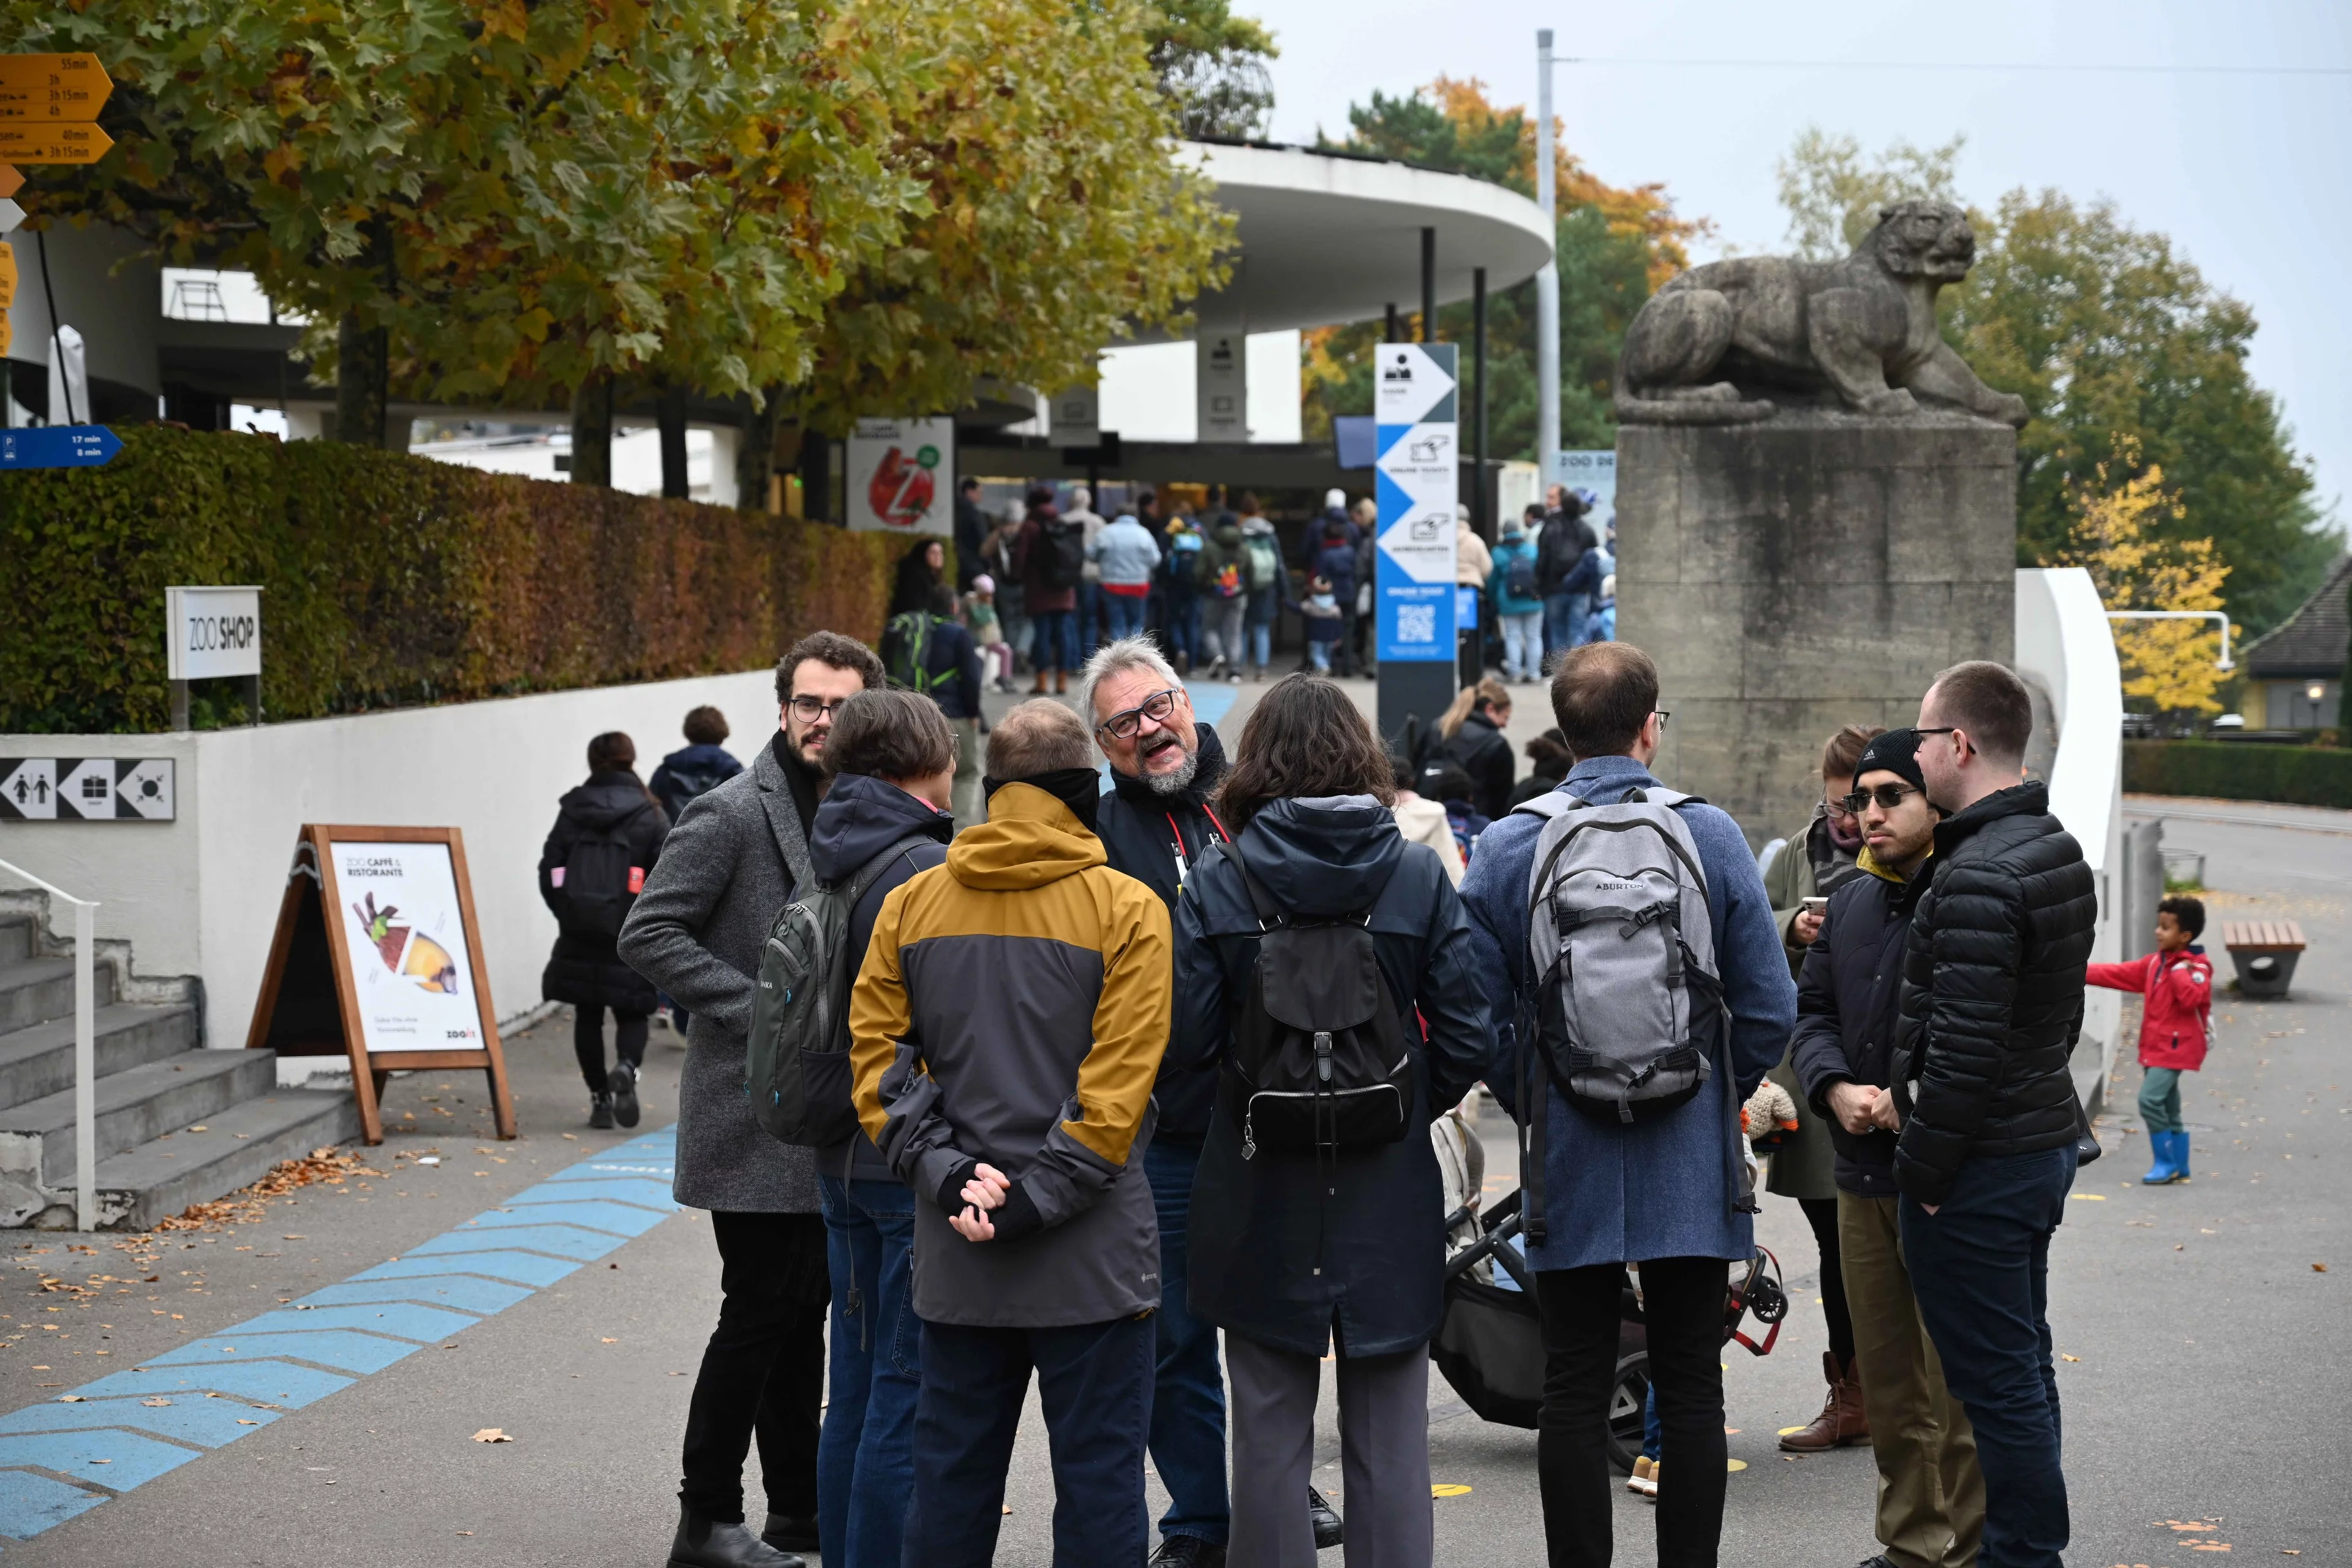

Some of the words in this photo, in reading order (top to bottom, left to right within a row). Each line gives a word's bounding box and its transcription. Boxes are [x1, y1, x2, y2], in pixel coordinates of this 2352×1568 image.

[85, 435, 101, 443] min
[85, 448, 102, 456] min
[189, 616, 216, 651] ZOO
[219, 615, 254, 650] SHOP
[347, 868, 403, 877] RISTORANTE
